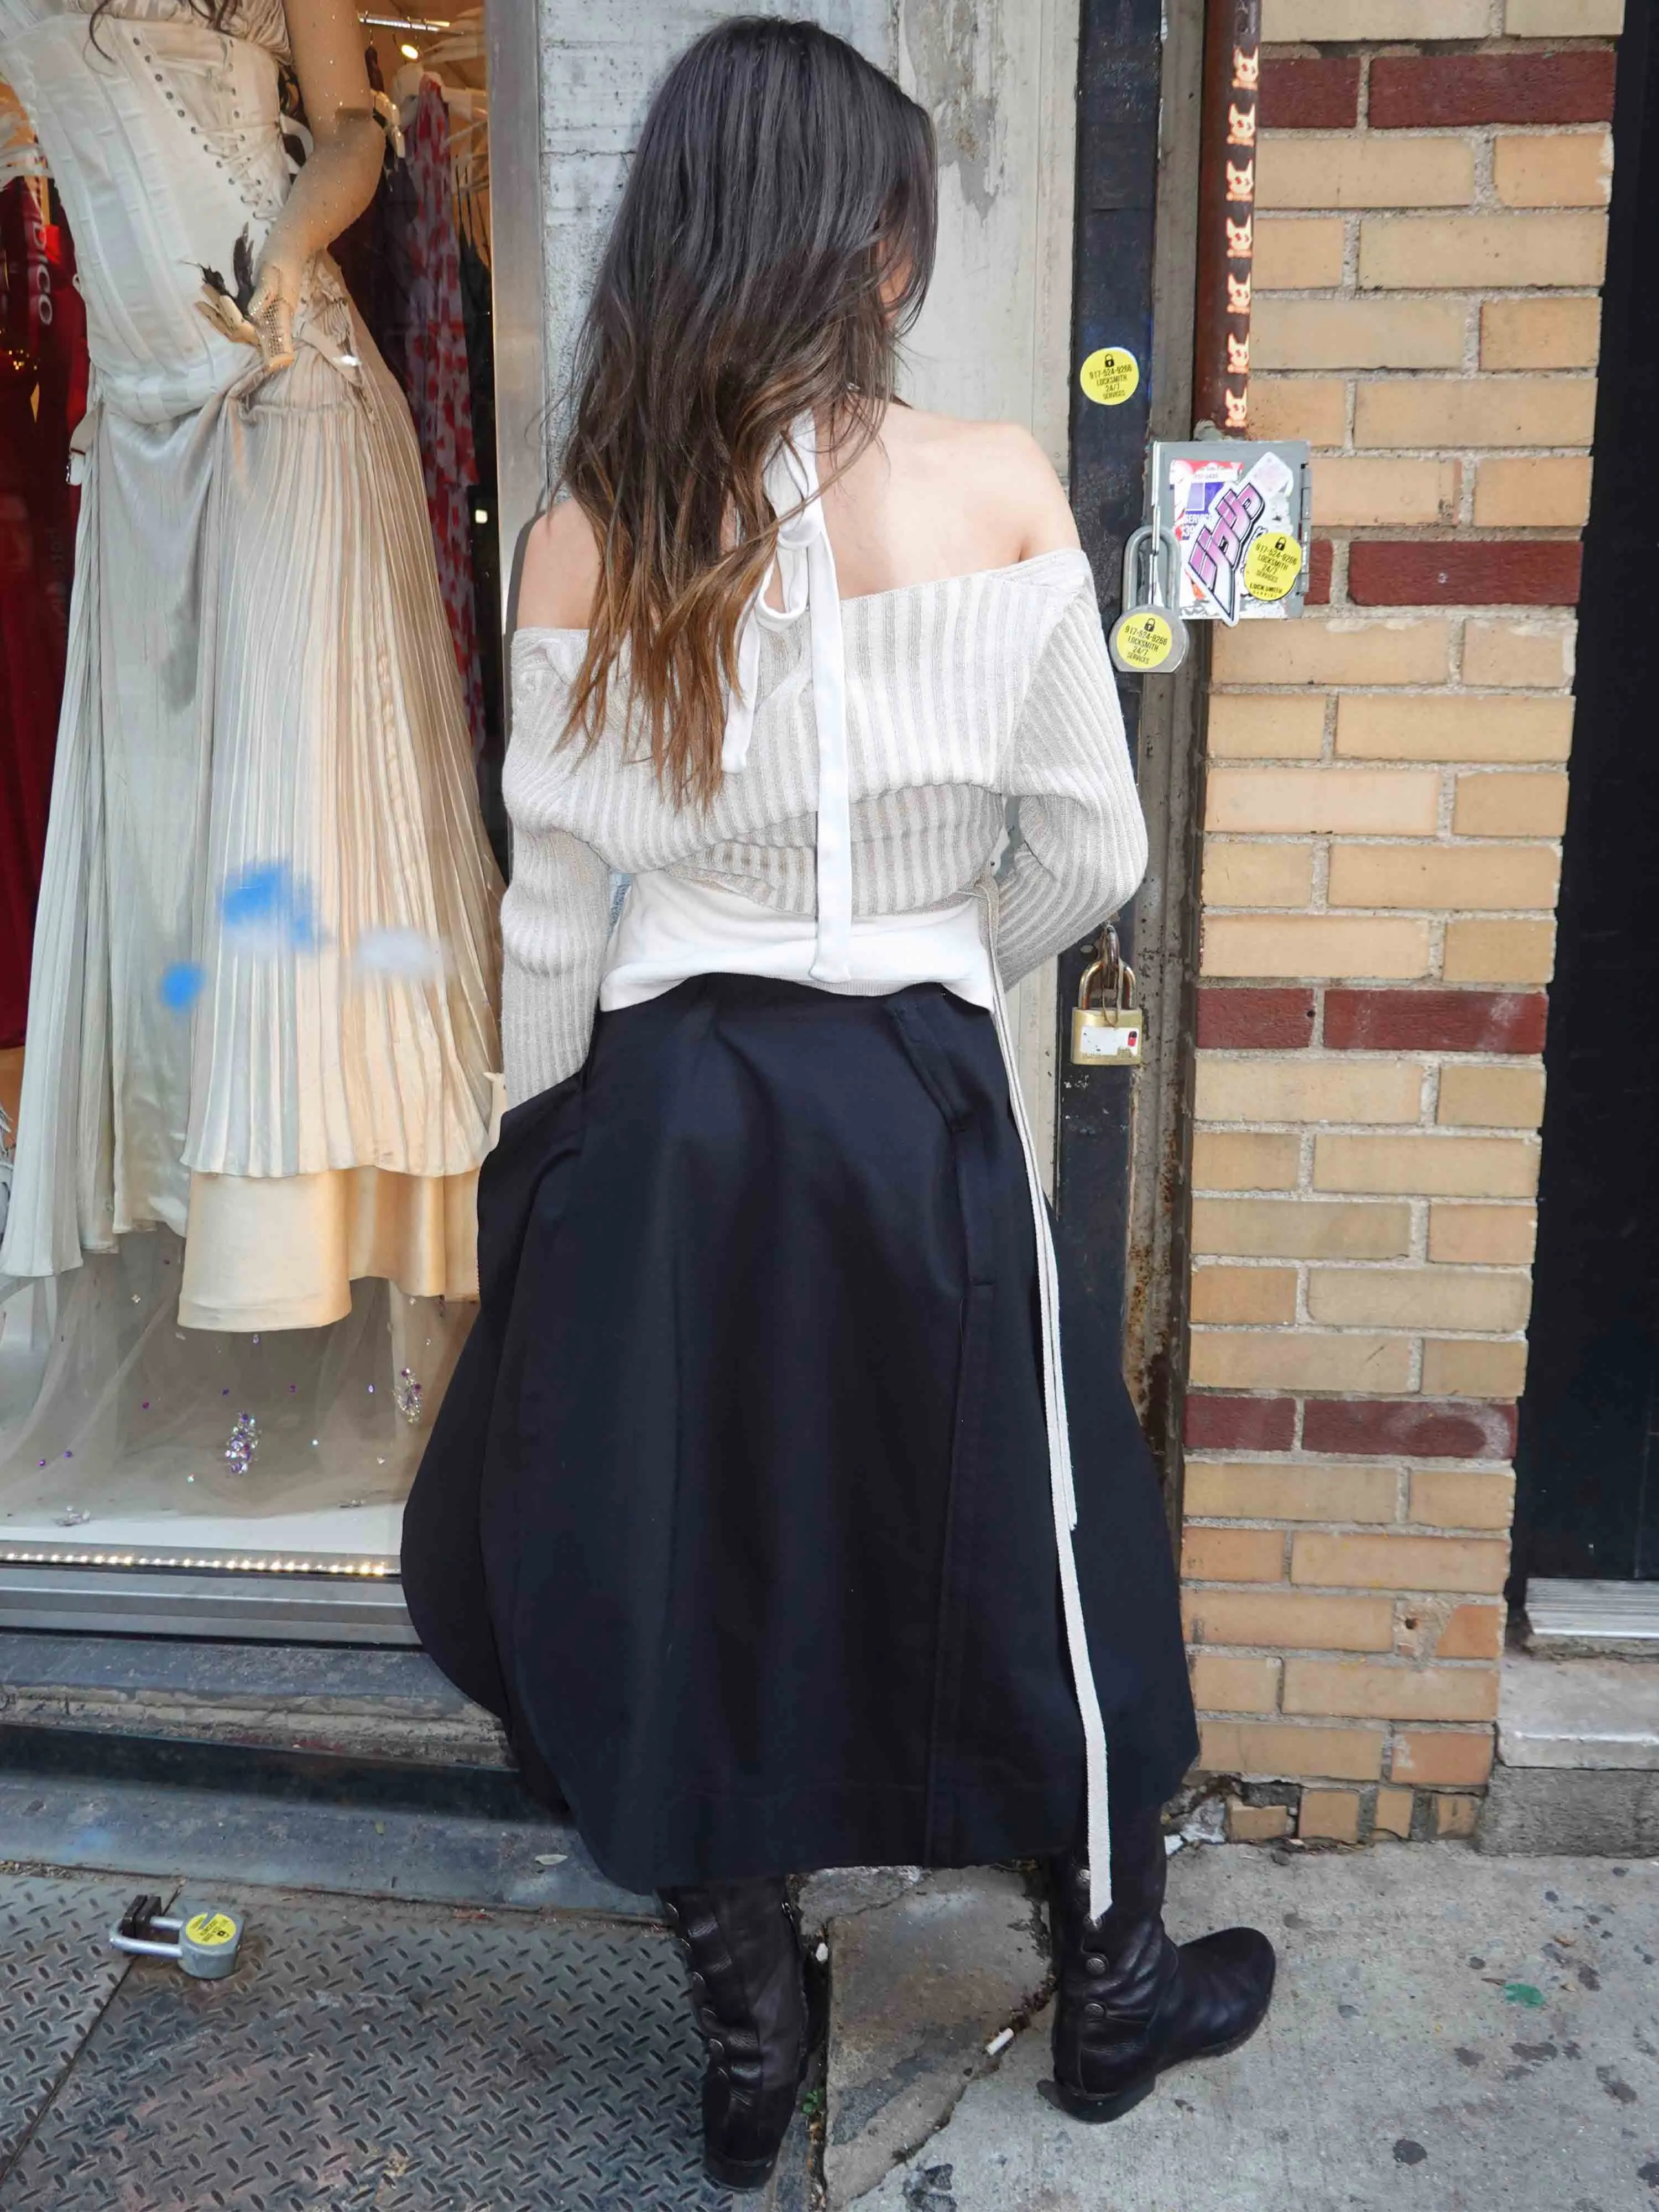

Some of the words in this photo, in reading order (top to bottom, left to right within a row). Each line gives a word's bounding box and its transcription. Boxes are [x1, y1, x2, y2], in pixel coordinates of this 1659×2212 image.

[1105, 383, 1120, 392] 24/7
[1257, 554, 1288, 571] LOCKSMITH
[1262, 564, 1277, 575] 24/7
[1123, 625, 1168, 646] 917-524-9266
[1128, 635, 1159, 652] LOCKSMITH
[1133, 645, 1149, 656] 24/7
[1126, 651, 1150, 664] SERVICES
